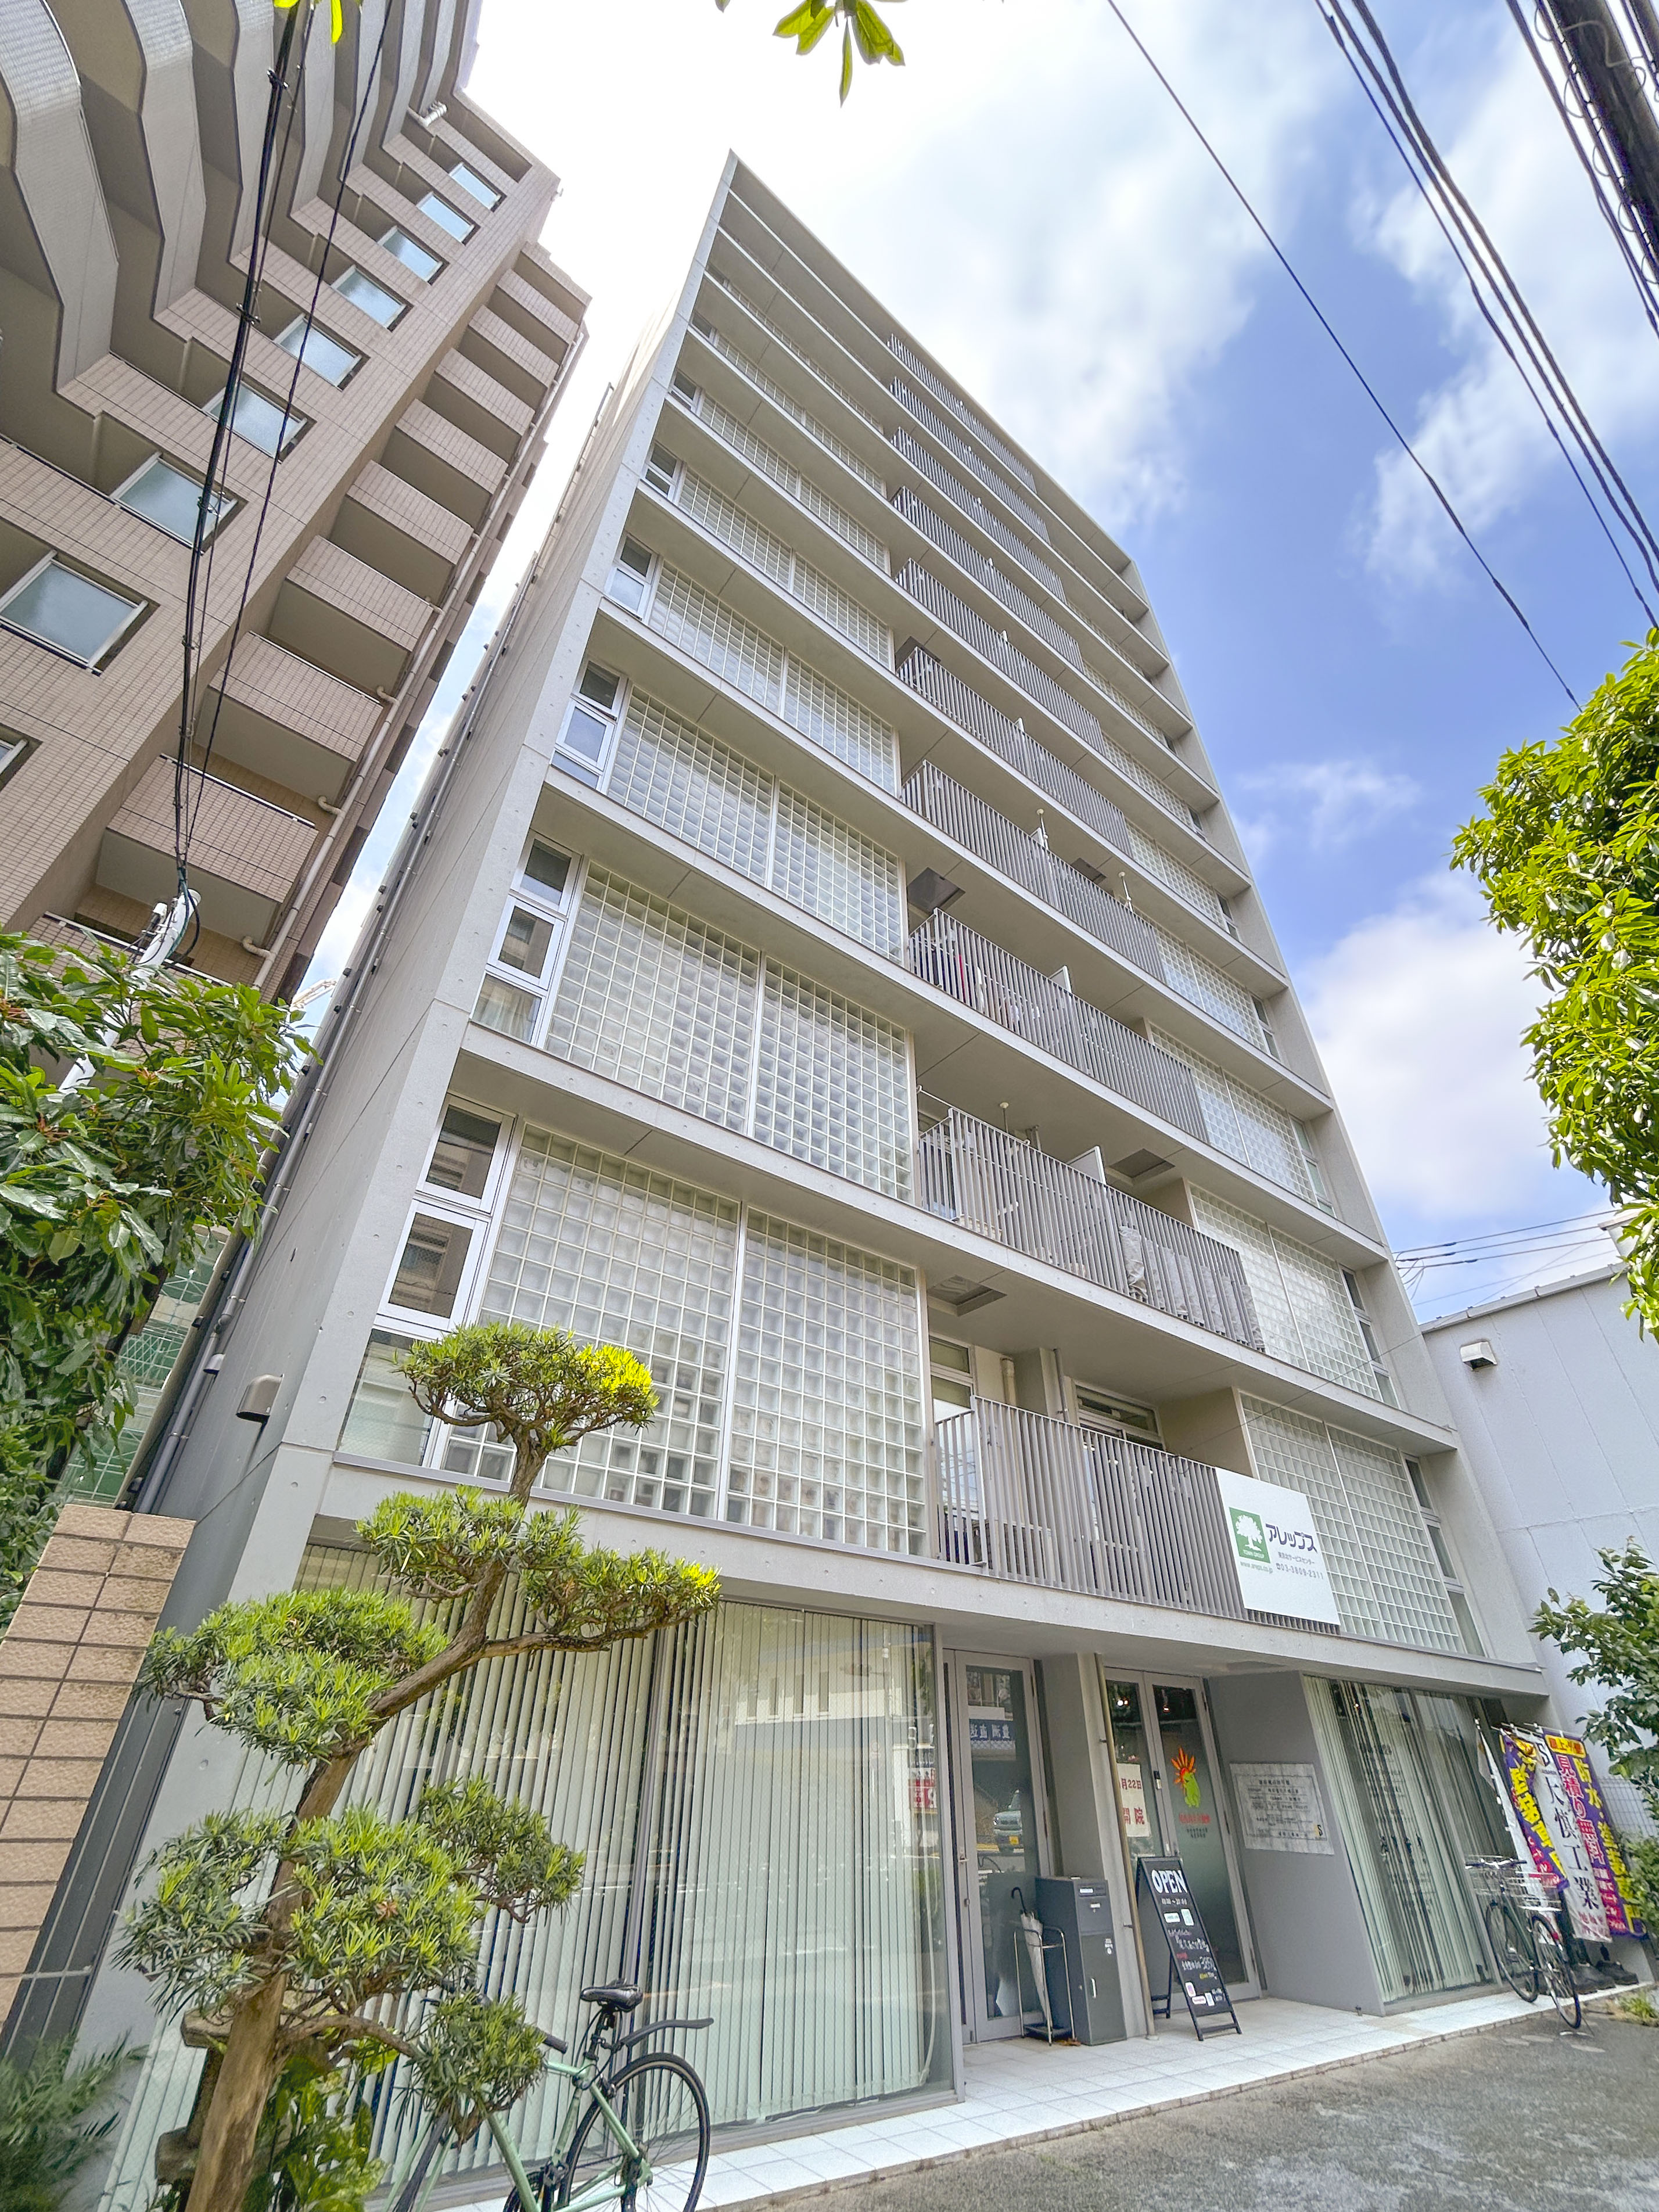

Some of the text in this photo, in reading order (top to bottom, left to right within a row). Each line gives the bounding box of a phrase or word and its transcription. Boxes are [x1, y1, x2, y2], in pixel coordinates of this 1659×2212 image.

[1265, 1523, 1317, 1553] アレップス
[1555, 1754, 1606, 1865] 見積り無料
[1151, 1869, 1188, 1894] OPEN
